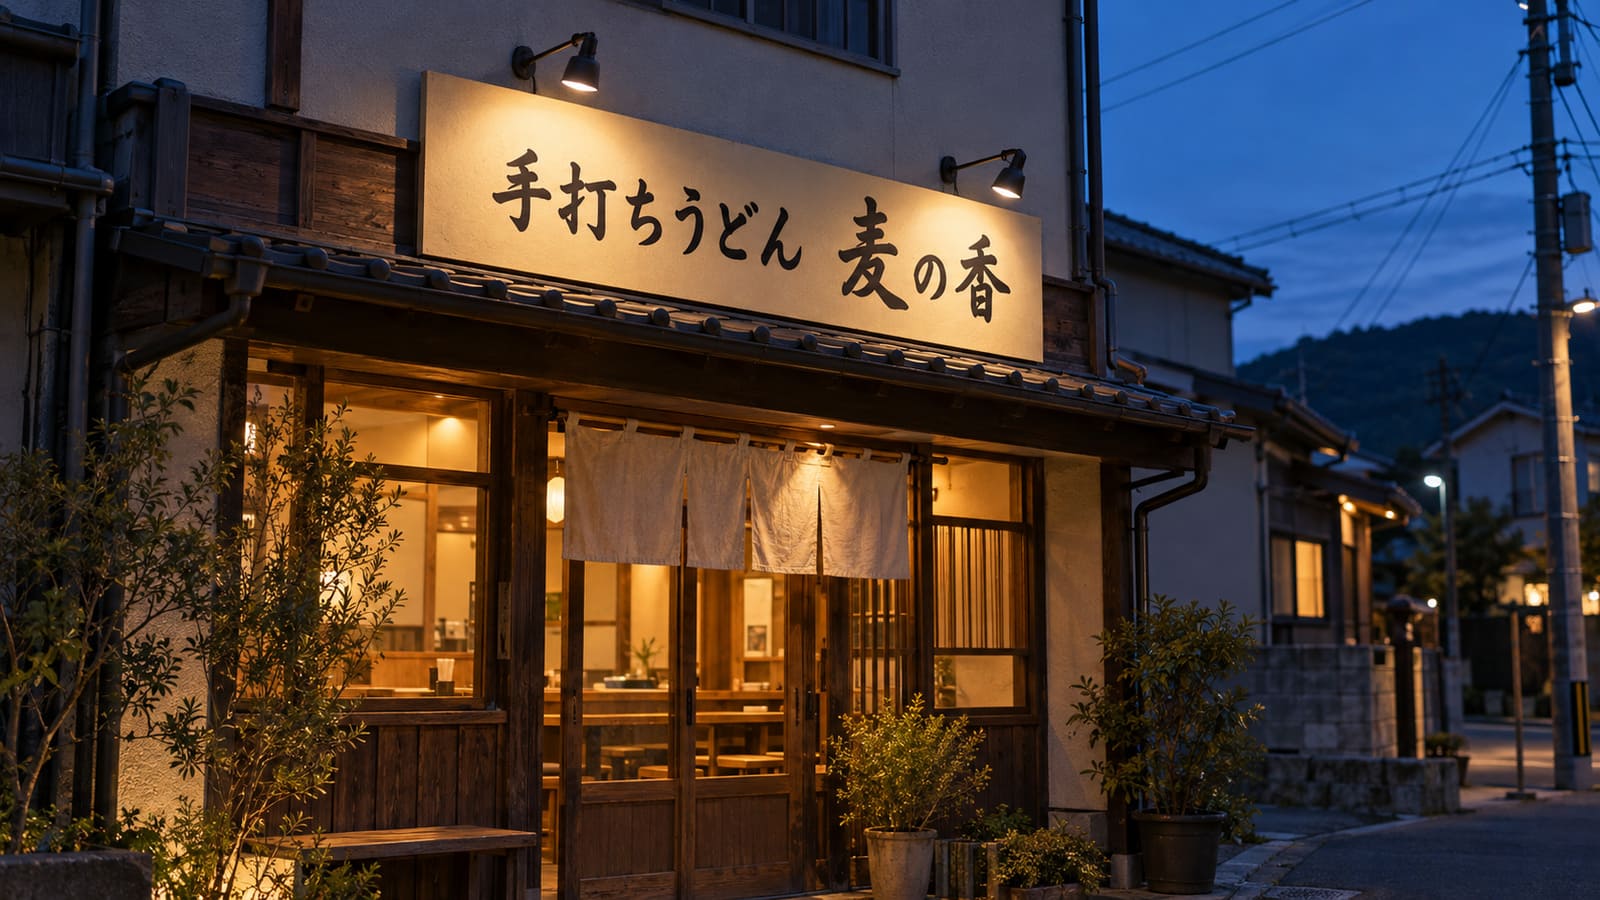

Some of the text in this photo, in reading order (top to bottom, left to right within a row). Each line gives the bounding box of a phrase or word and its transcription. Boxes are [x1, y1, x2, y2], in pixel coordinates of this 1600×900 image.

[492, 148, 1011, 323] 手打ちうどん 麦の香
